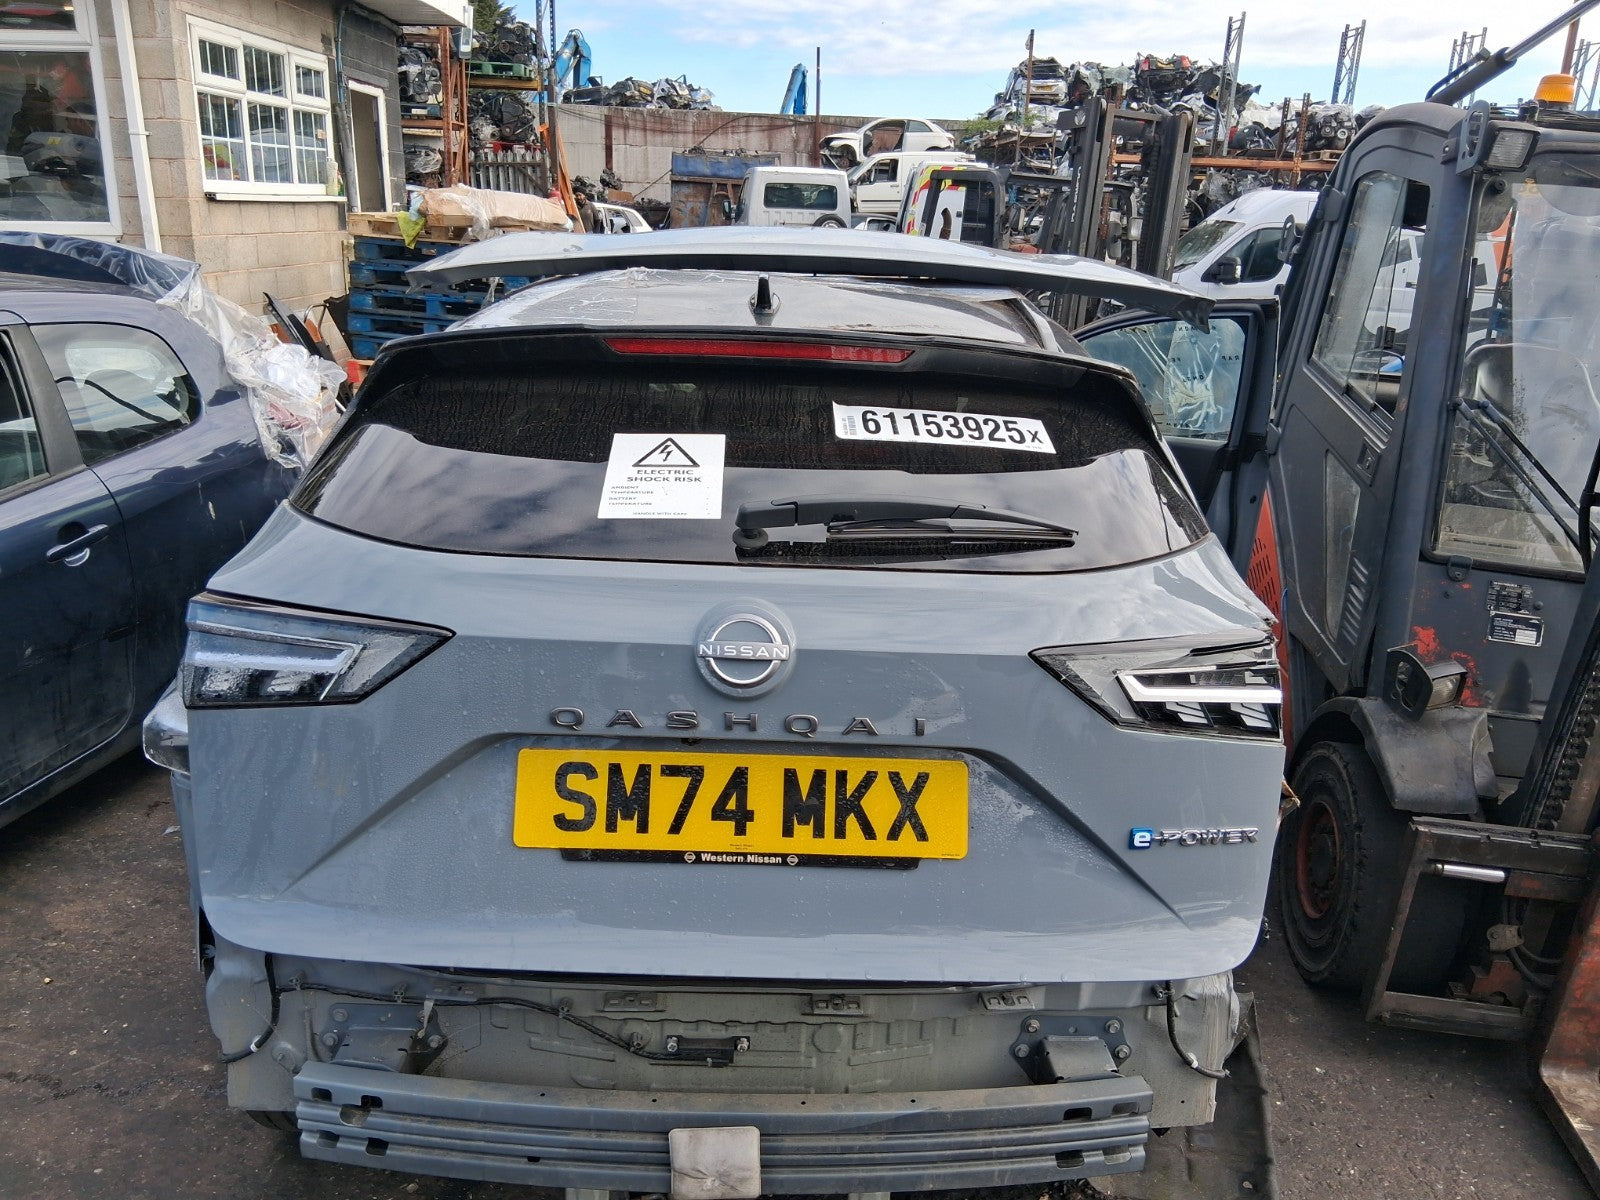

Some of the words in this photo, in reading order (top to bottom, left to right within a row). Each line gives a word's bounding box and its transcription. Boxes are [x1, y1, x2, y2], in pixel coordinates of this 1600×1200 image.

[699, 643, 787, 659] NISSAN
[549, 706, 926, 738] QASHQAI
[552, 761, 755, 837] SM74
[781, 767, 931, 842] MKX
[700, 852, 744, 863] Western
[746, 854, 782, 864] Nissan
